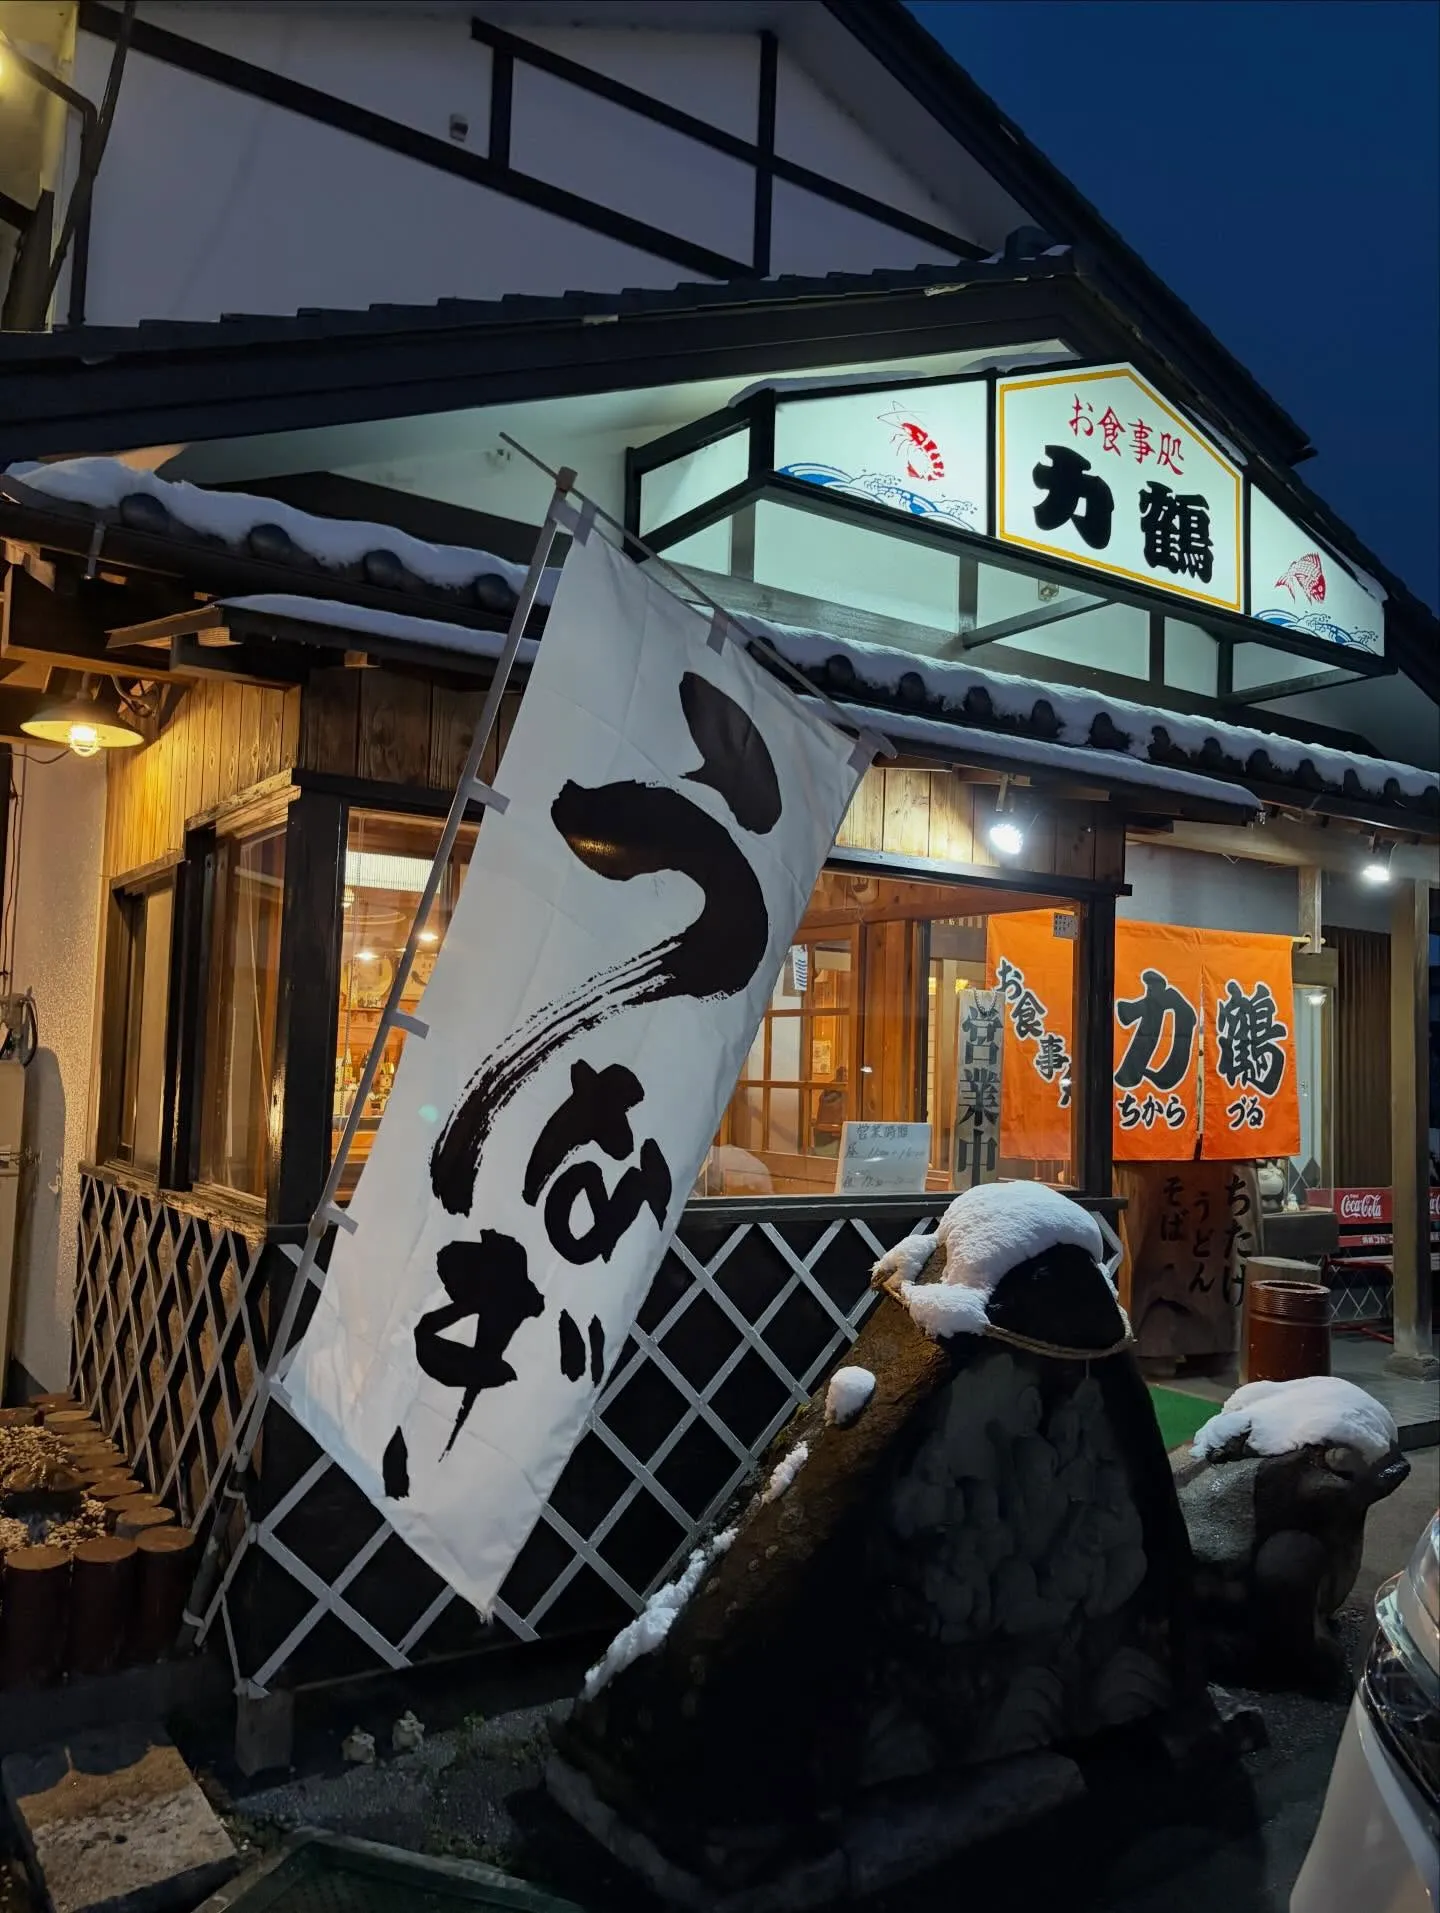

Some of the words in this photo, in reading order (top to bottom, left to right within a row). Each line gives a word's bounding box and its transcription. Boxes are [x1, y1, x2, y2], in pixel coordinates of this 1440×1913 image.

[1069, 393, 1184, 475] お食事処
[1032, 444, 1214, 584] 力鶴
[383, 671, 782, 1499] うなぎ
[1114, 969, 1287, 1097] 力鶴
[958, 1006, 1003, 1188] 営業中
[1118, 1095, 1186, 1130] ちから
[1160, 1175, 1190, 1242] そば
[1188, 1191, 1216, 1293] うどん
[1222, 1174, 1253, 1307] ちたけ
[1340, 1194, 1381, 1218] Coca-Cola
